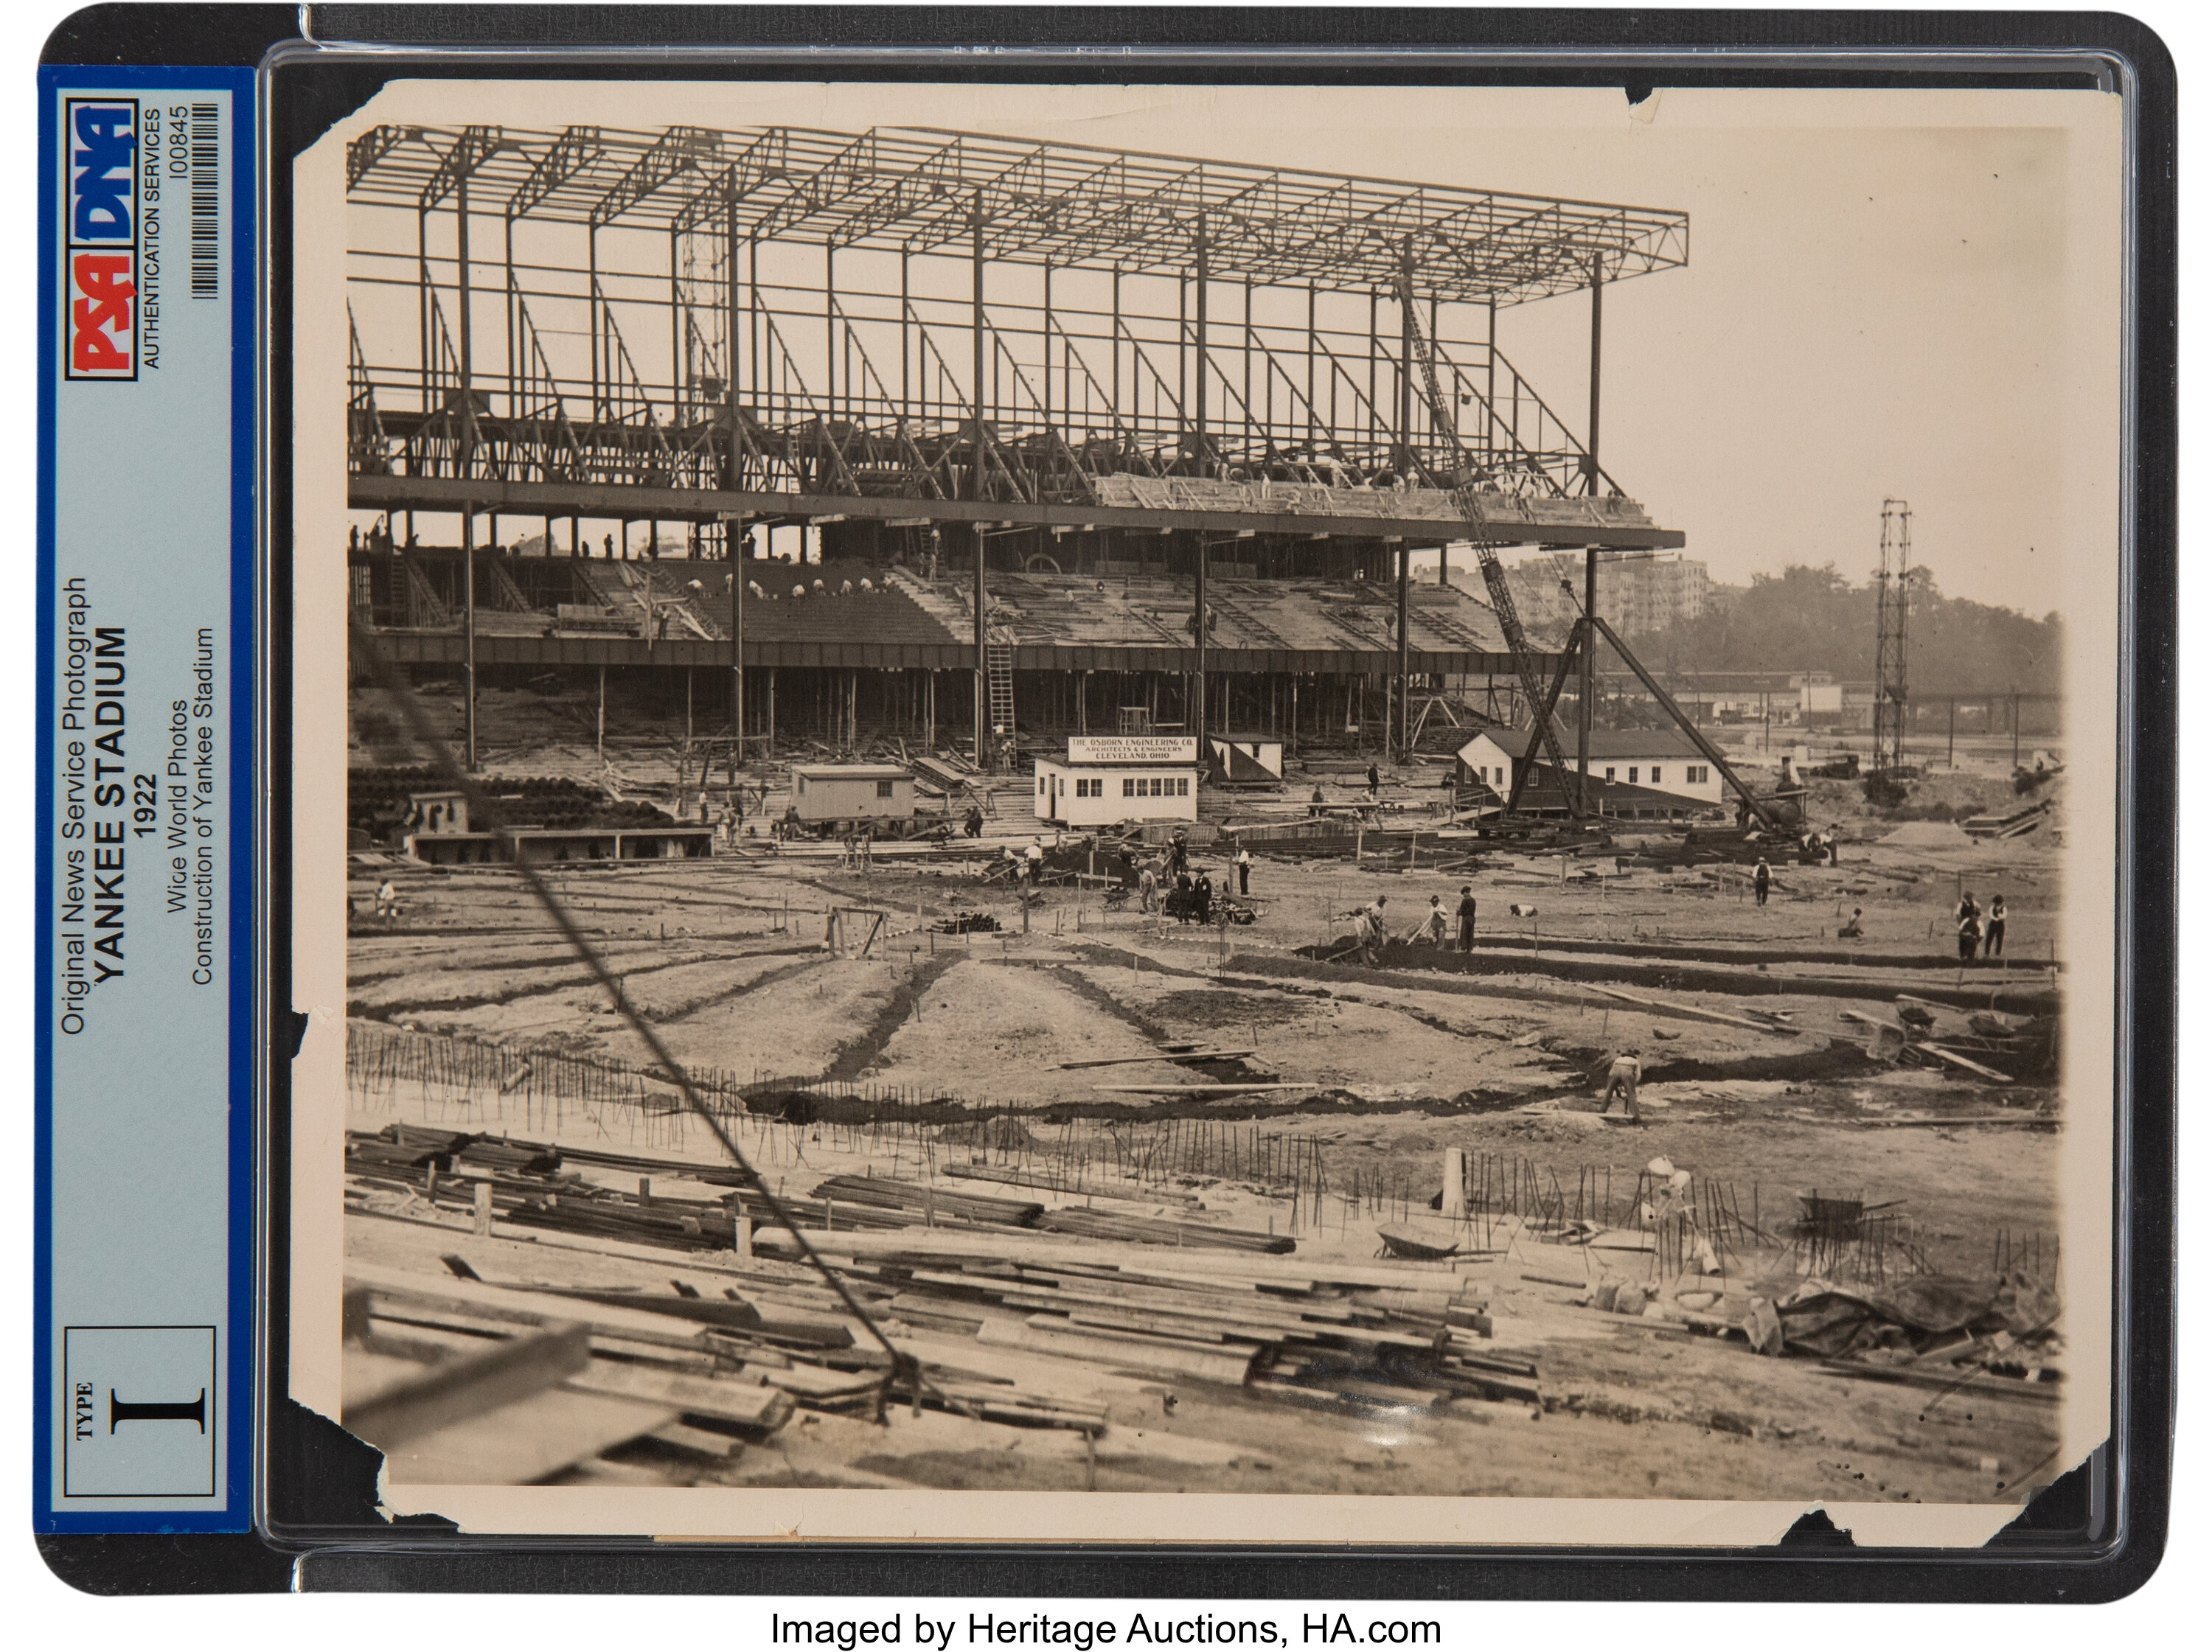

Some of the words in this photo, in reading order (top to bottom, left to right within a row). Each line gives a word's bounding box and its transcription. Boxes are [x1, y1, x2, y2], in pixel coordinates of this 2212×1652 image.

[74, 105, 138, 240] DNA
[144, 108, 161, 202] SERVICES
[74, 254, 138, 372] PSA
[144, 208, 160, 369] AUTHENTICATION
[62, 578, 92, 731] Photograph
[192, 628, 213, 719] Stadium
[94, 627, 126, 808] STADIUM
[167, 700, 188, 776] Photos
[61, 741, 86, 840] Service
[133, 774, 157, 838] 1922
[192, 726, 213, 811] Yankee
[167, 785, 187, 850] World
[192, 816, 213, 838] of
[61, 849, 85, 922] News
[94, 820, 125, 987] YANKEE
[192, 846, 213, 986] Construction
[60, 933, 91, 1035] Original
[76, 1381, 93, 1442] TYPE
